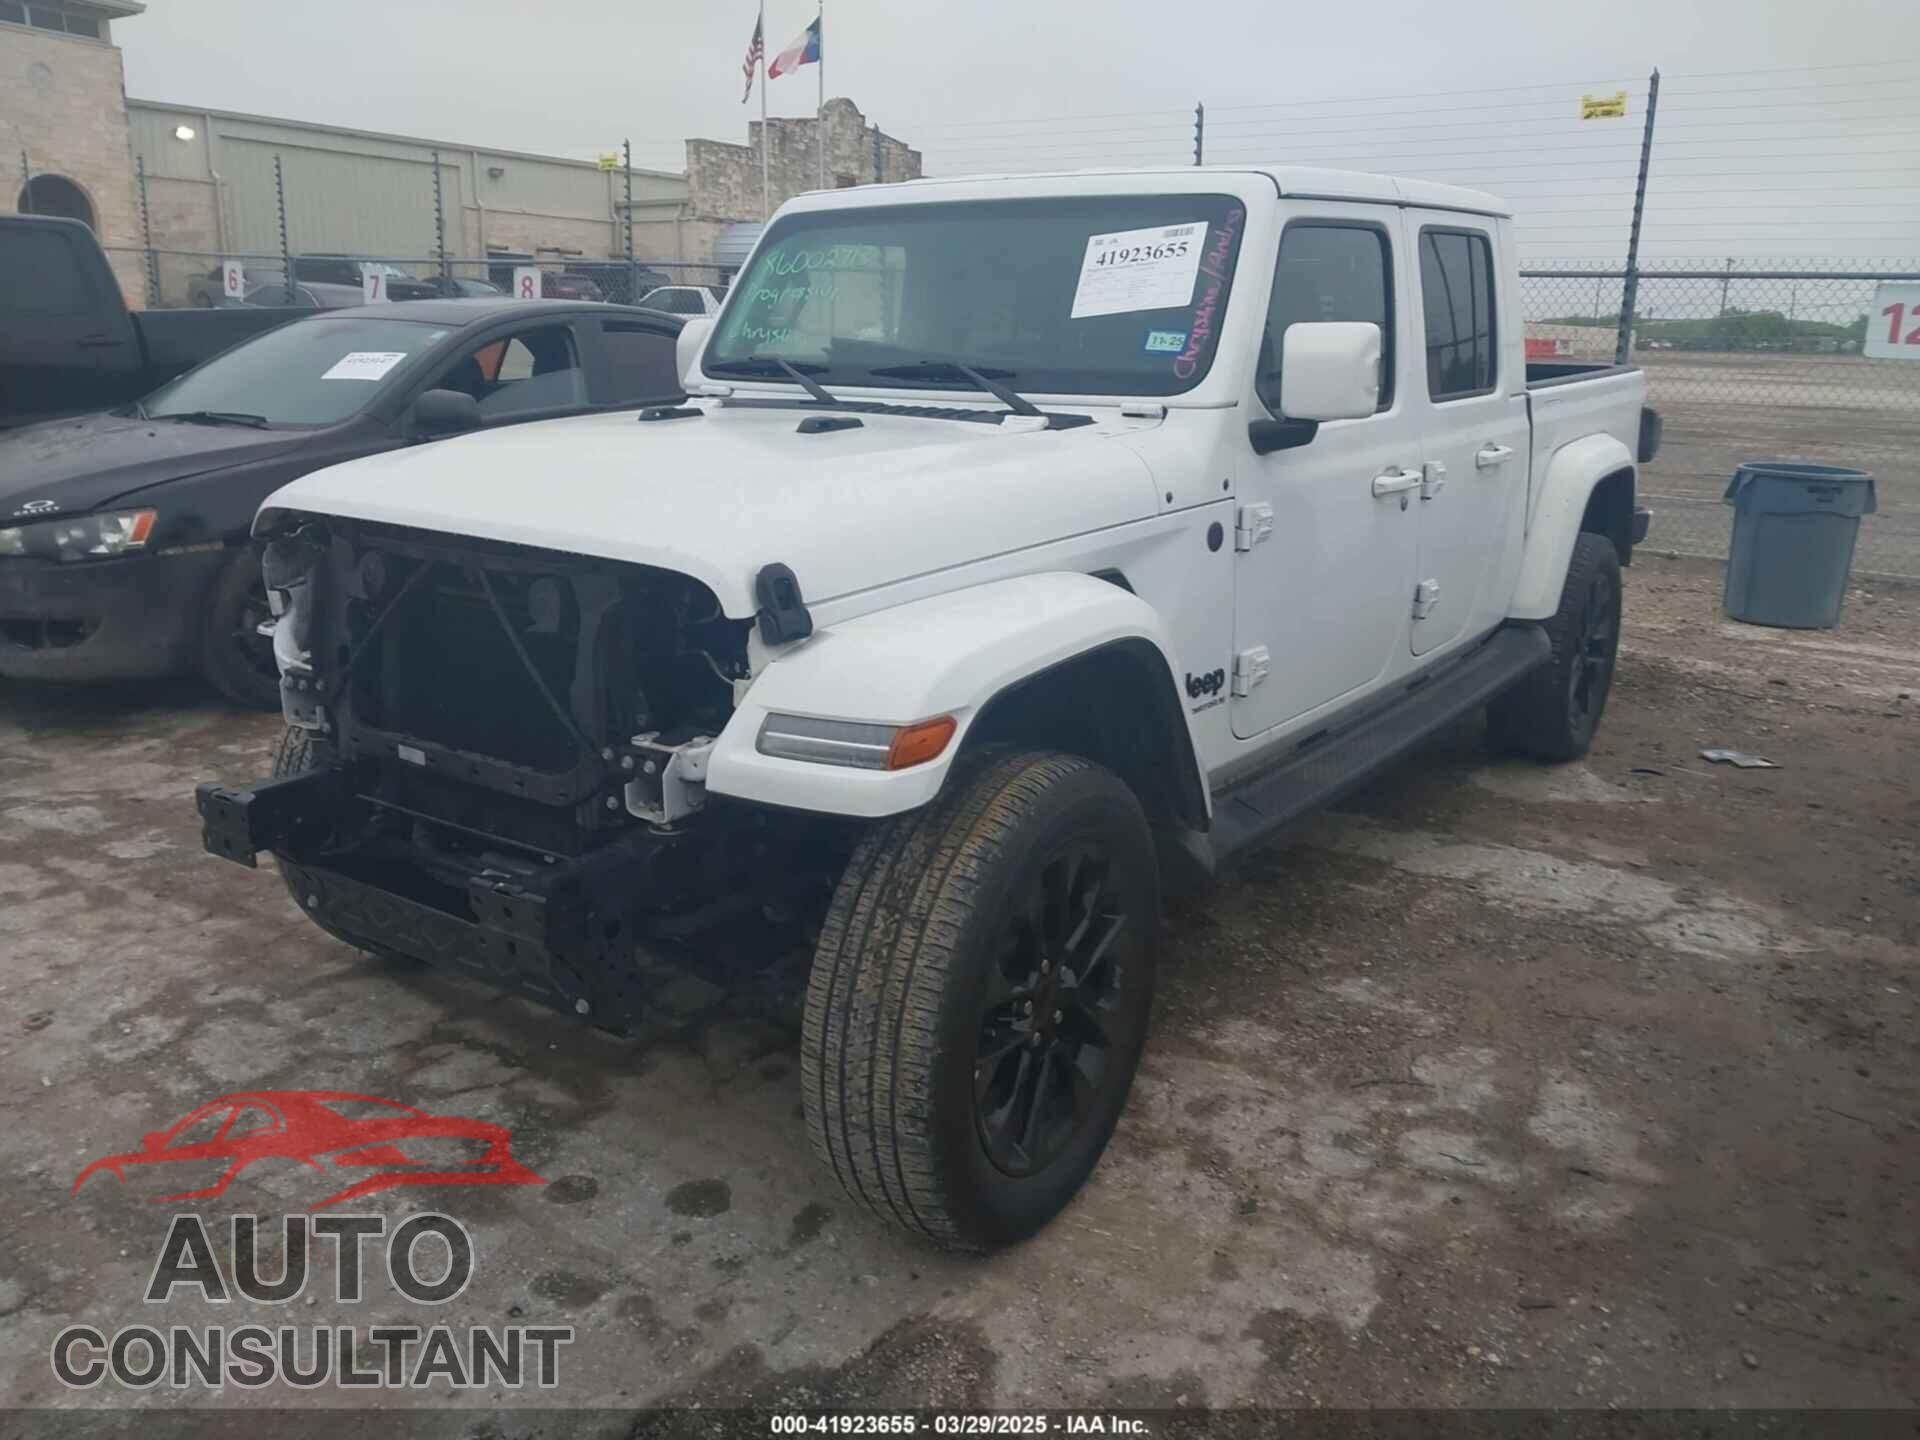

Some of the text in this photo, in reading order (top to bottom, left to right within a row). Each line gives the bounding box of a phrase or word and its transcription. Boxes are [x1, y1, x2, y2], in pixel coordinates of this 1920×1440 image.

[1095, 241, 1189, 266] 41923655
[228, 268, 238, 290] 6
[370, 274, 380, 299] 7
[521, 275, 533, 299] 8
[1185, 668, 1224, 699] Jeep
